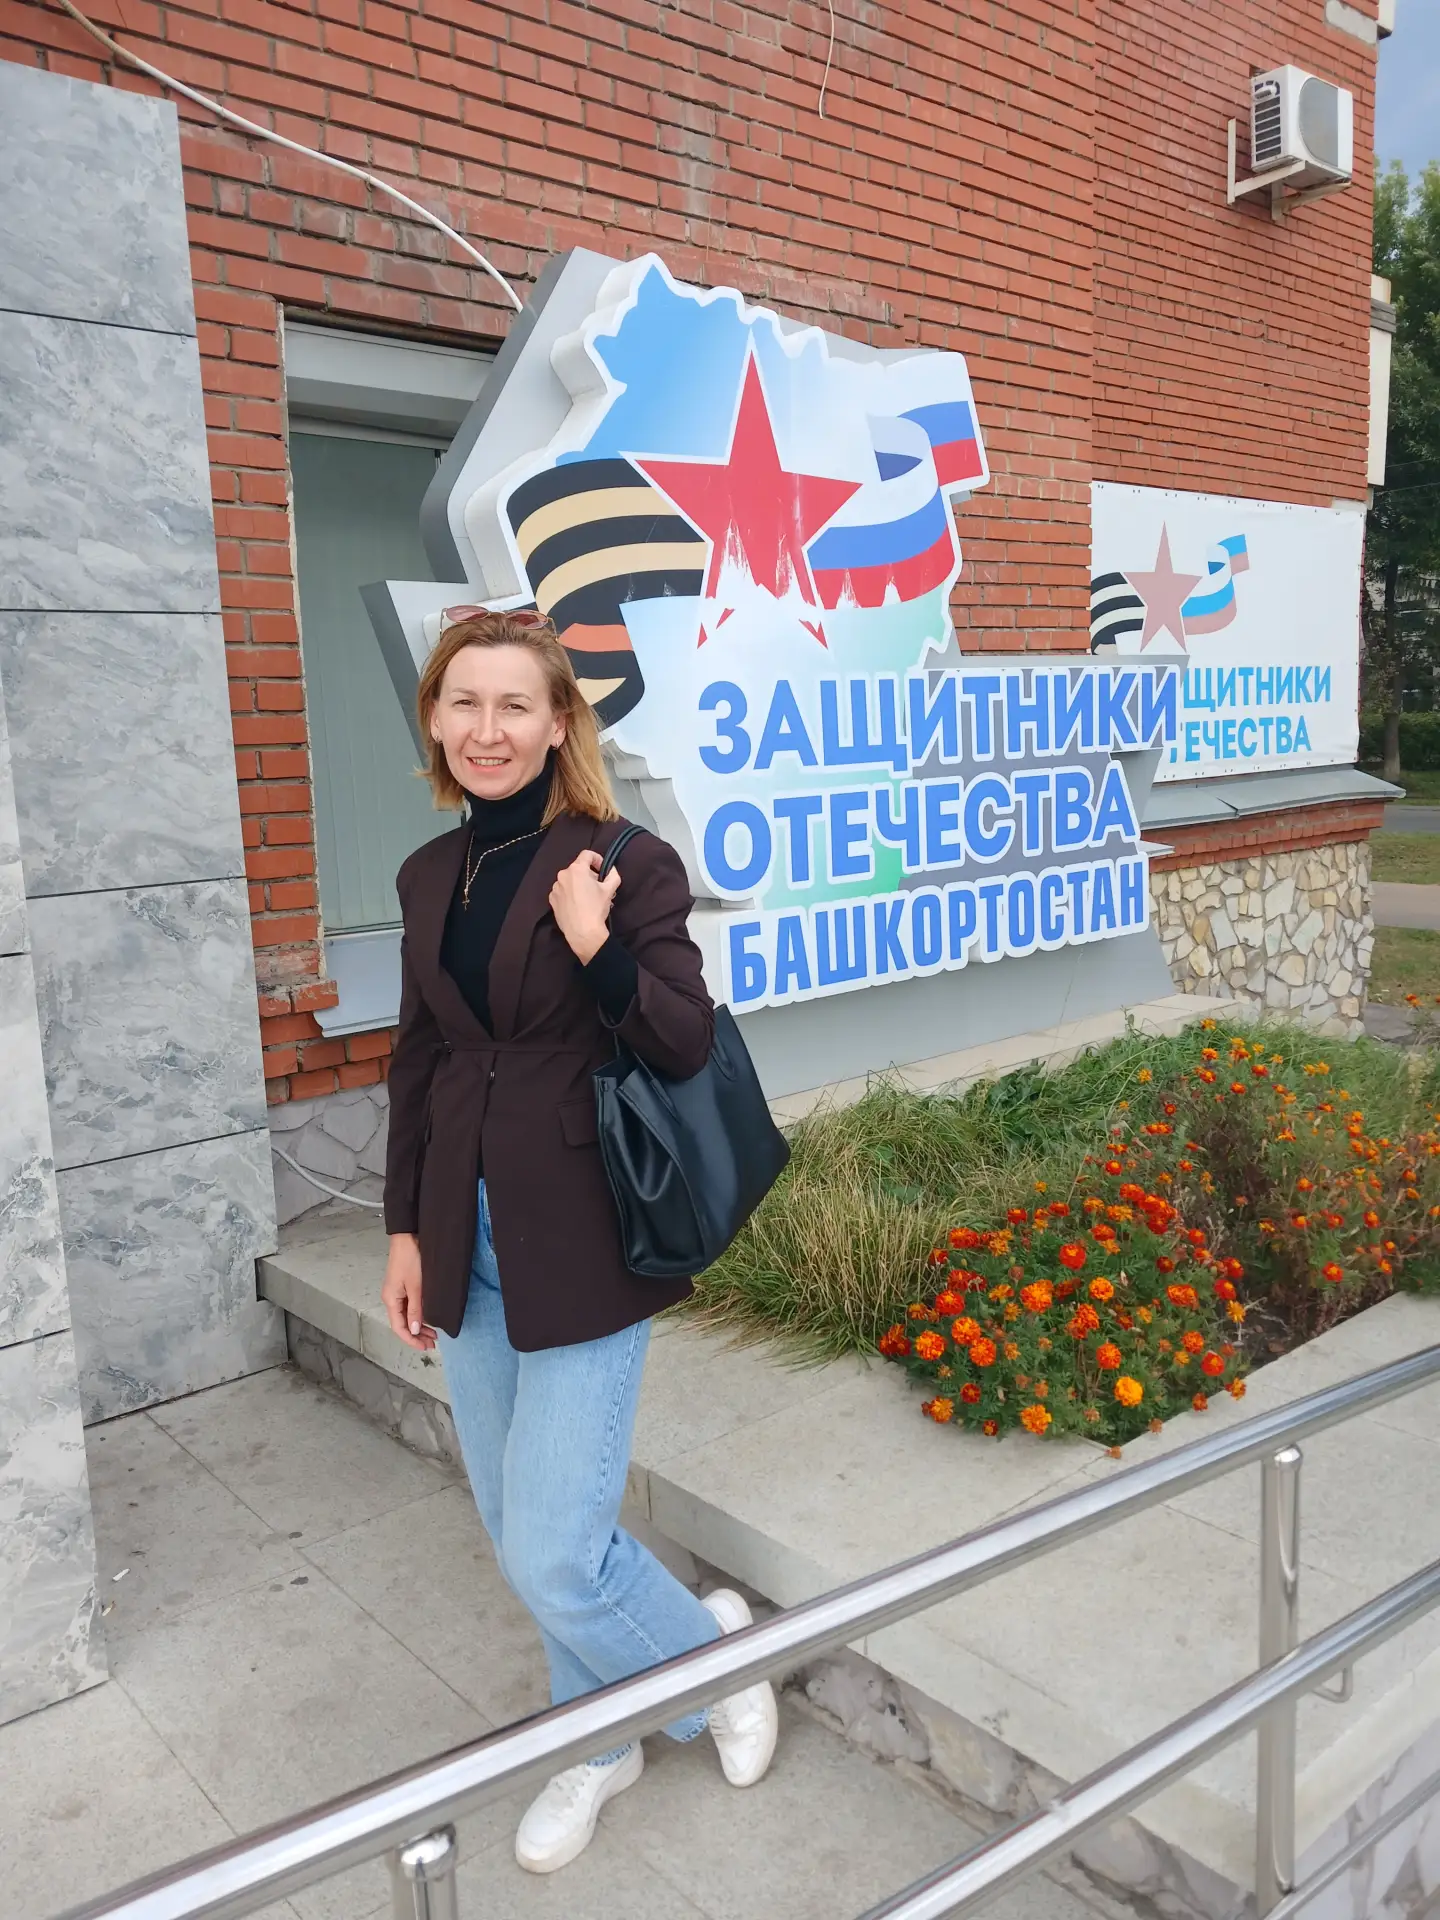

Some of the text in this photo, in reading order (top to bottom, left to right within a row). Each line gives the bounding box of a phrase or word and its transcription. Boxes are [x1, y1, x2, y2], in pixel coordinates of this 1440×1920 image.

[699, 671, 1177, 773] ЗАЩИТНИКИ
[1170, 715, 1312, 763] ЕЧЕСТВА
[1183, 665, 1332, 713] ЩИТНИКИ
[703, 767, 1138, 892] ОТЕЧЕСТВА
[729, 861, 1144, 1004] БАШКОРТОСТАН
